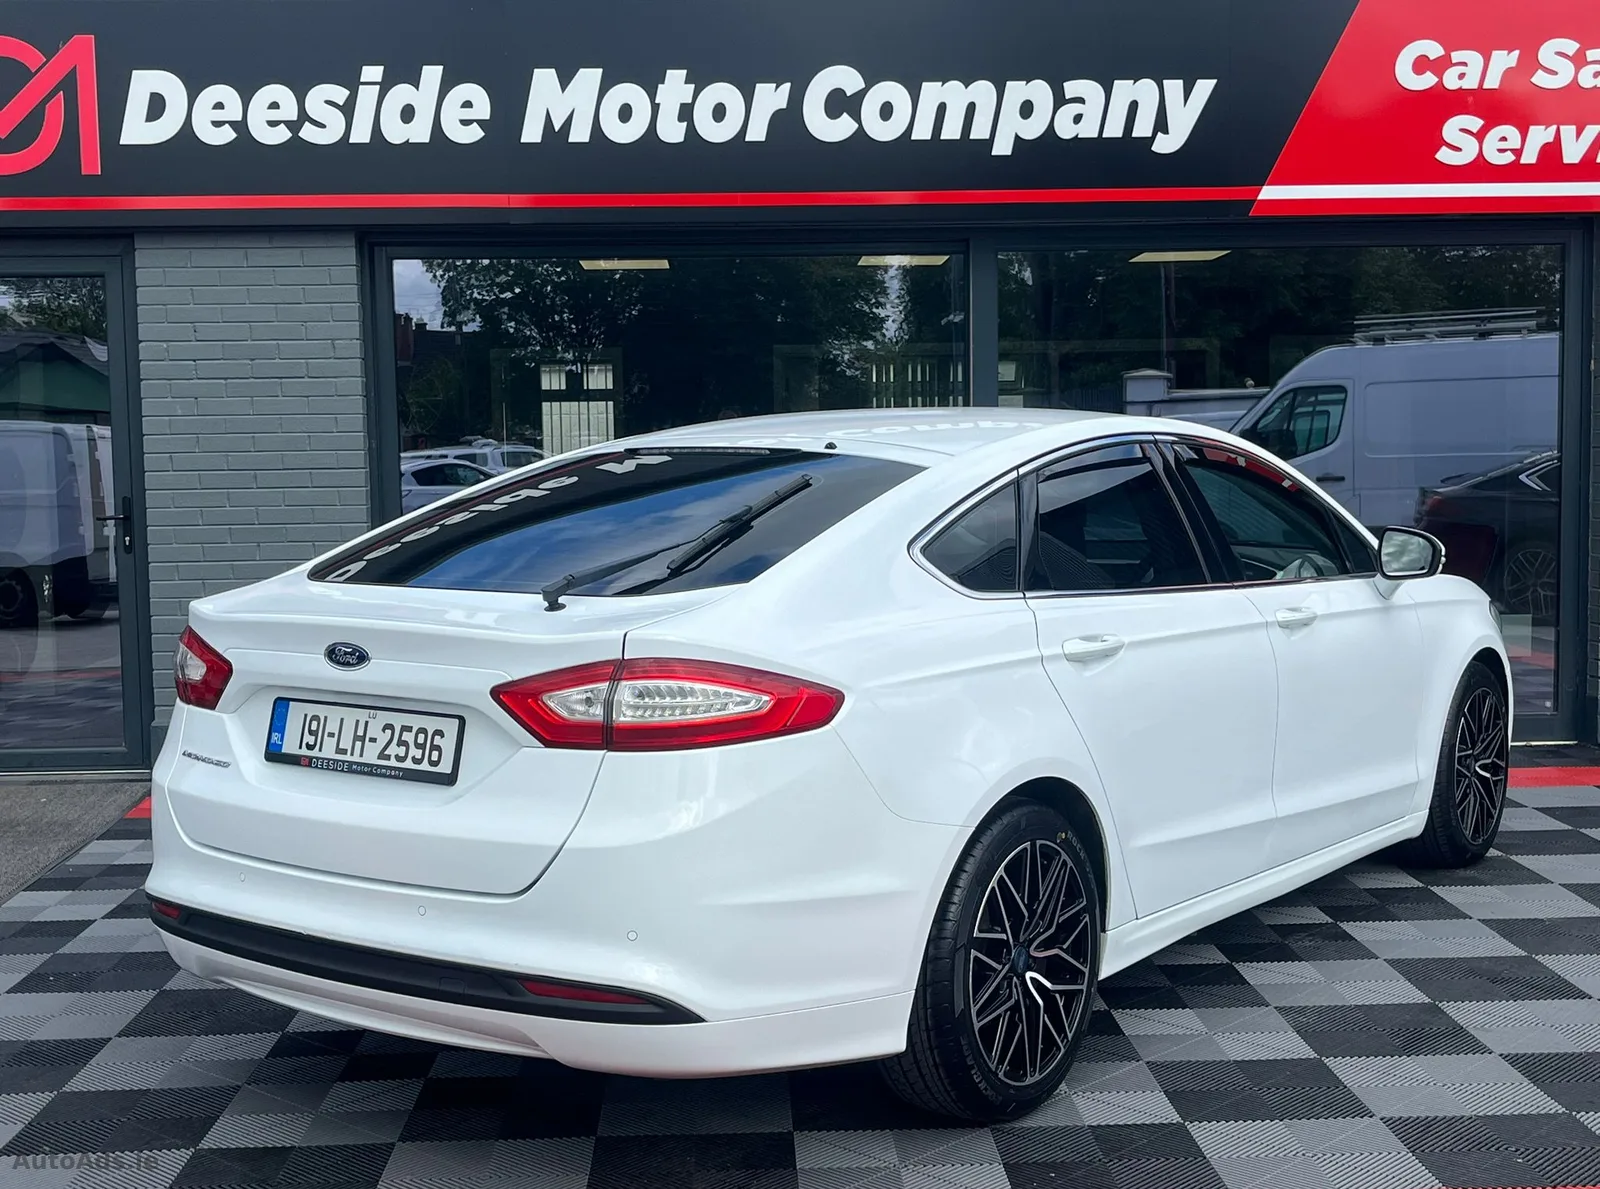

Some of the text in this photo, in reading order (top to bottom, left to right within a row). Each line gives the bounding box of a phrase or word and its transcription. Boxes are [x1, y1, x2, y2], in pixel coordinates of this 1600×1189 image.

[1394, 39, 1520, 91] Car
[119, 64, 491, 146] Deeside
[520, 66, 791, 144] Motor
[803, 64, 1218, 156] Company
[1434, 114, 1600, 166] Serv
[332, 646, 359, 664] Ford
[270, 731, 283, 746] IRL
[298, 713, 446, 768] 191-LH-2596
[311, 758, 349, 771] DEESIDE
[351, 764, 372, 773] Motor
[372, 767, 404, 778] Company
